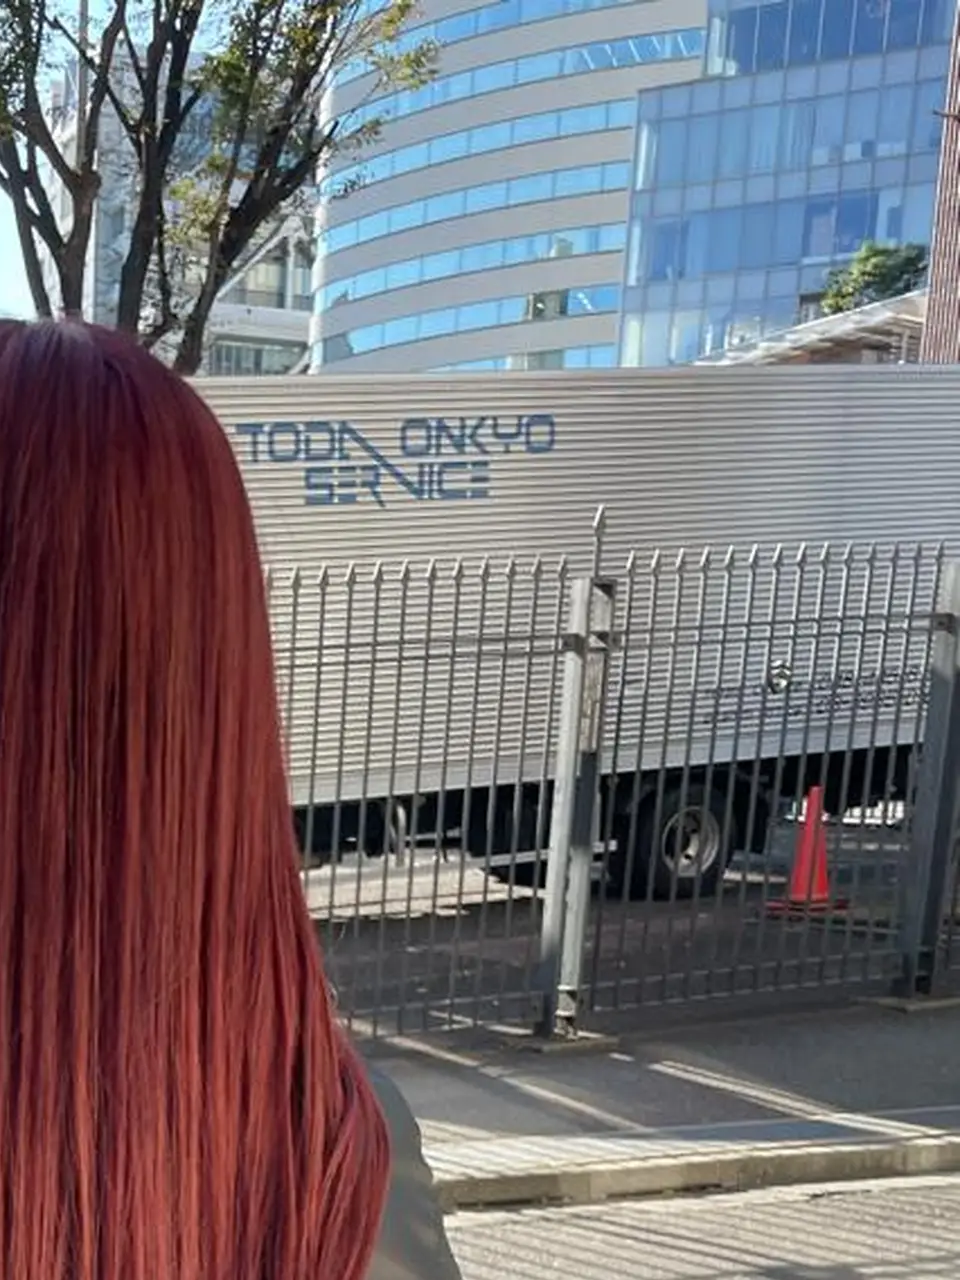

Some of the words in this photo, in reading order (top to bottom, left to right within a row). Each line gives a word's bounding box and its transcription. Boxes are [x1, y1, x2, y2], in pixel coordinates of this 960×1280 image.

[235, 419, 382, 463] TODA
[400, 413, 556, 457] ONKYO
[304, 459, 490, 508] SERVICE
